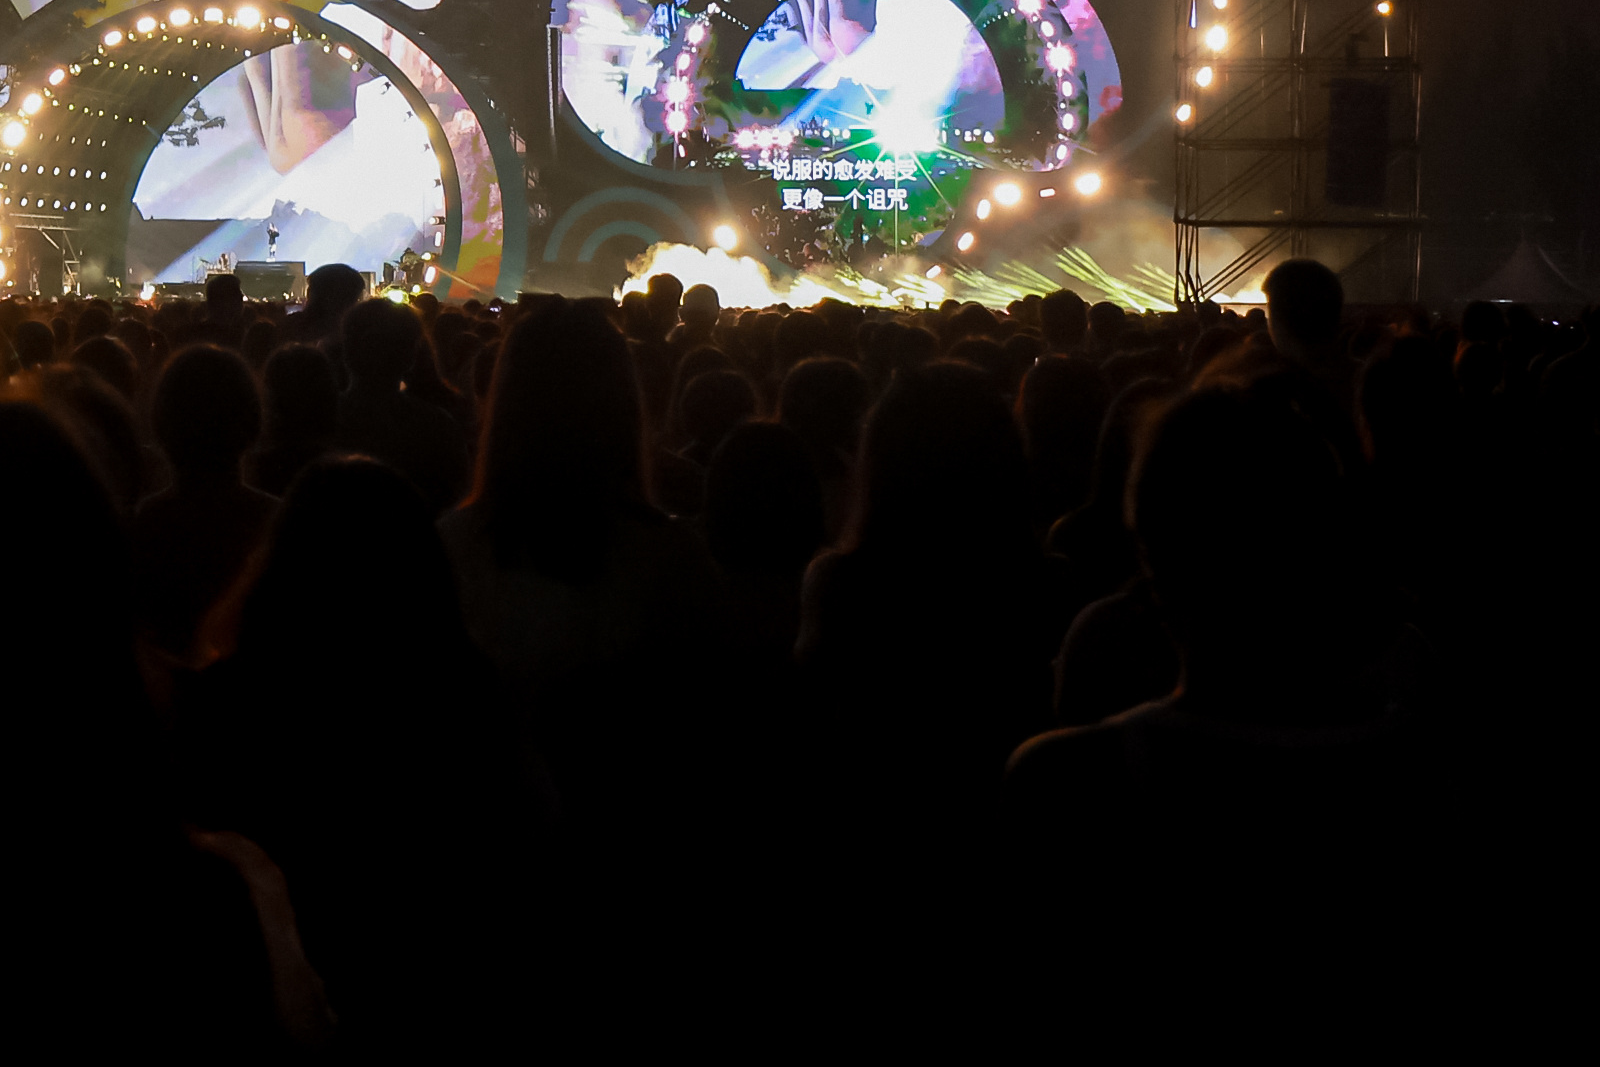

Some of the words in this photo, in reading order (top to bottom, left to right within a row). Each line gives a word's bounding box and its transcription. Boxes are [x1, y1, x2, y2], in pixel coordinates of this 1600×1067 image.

[771, 158, 918, 182] 说服的愈发难受
[781, 187, 909, 211] 更像一个诅咒
